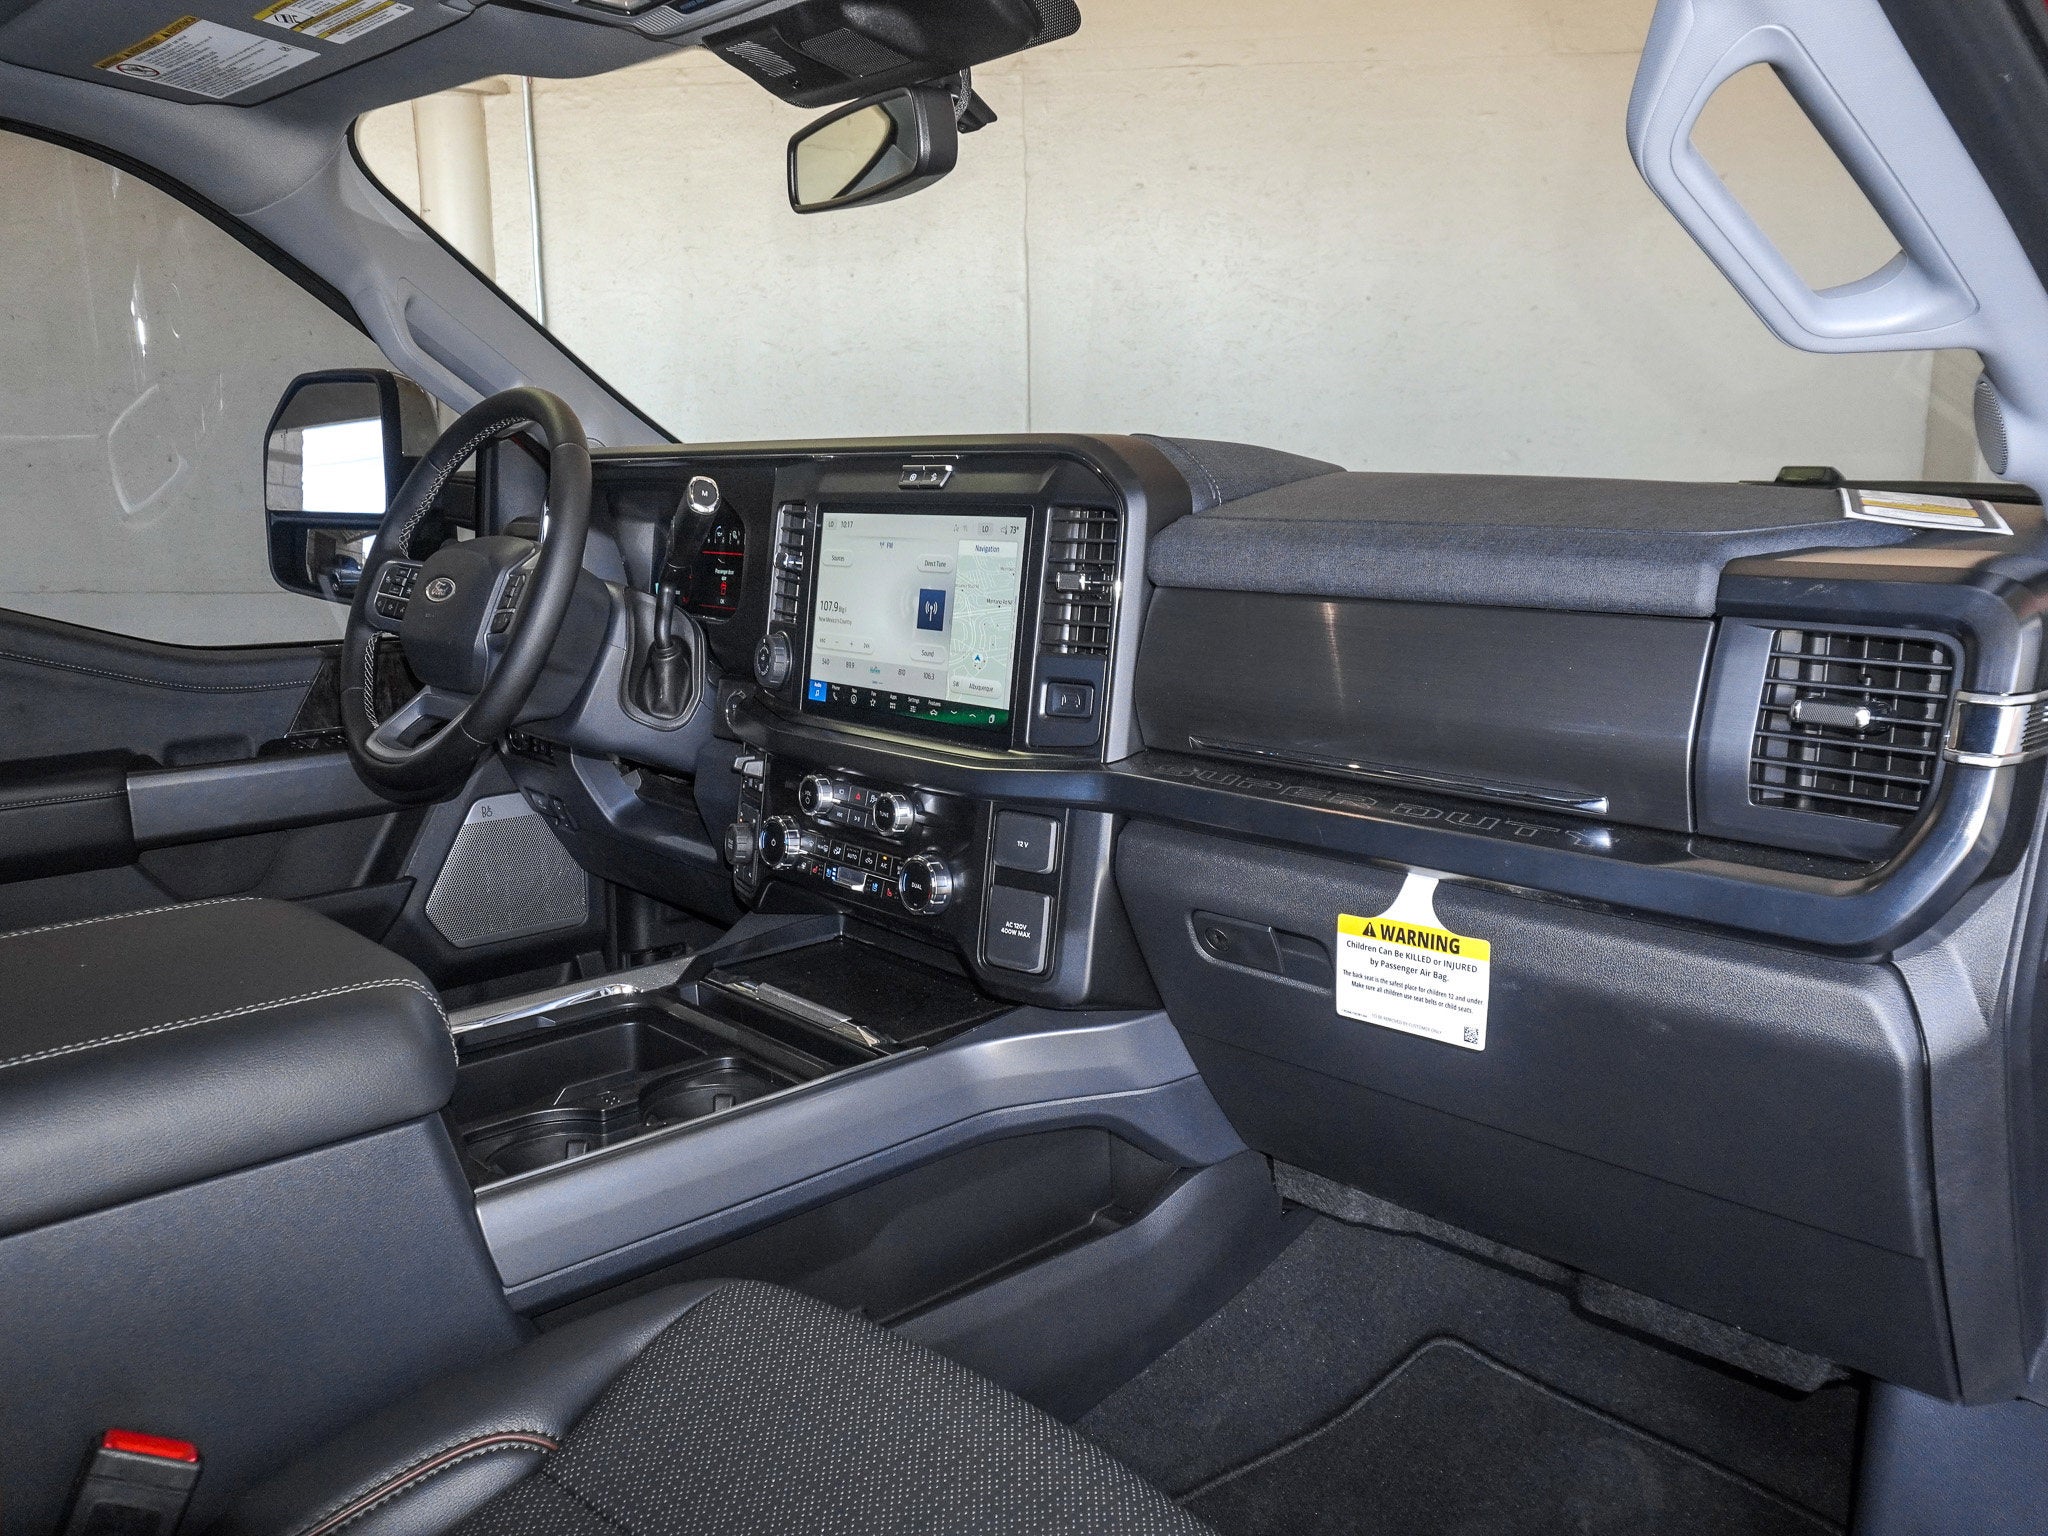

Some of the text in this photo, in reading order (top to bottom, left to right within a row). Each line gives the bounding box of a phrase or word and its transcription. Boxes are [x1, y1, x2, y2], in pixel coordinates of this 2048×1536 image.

[975, 545, 1000, 553] Navigation
[820, 600, 839, 612] 107.9
[921, 650, 934, 658] Sound
[879, 810, 889, 818] TUNE
[1017, 840, 1023, 848] 12
[847, 852, 858, 860] AUTO
[911, 881, 922, 890] DUAL
[1013, 922, 1027, 930] 120V
[1018, 930, 1031, 938] MAX
[1380, 924, 1460, 954] WARNING
[1346, 940, 1377, 953] Children
[1378, 947, 1392, 956] Can
[1394, 950, 1404, 958] Be
[1406, 952, 1431, 964] KILLED
[1443, 961, 1477, 973] INJURED
[1370, 958, 1449, 982] by Passenger Air Bag.
[1343, 969, 1351, 977] The
[1352, 971, 1362, 979] back
[1364, 974, 1374, 982] seat
[1380, 977, 1388, 985] the
[1389, 979, 1403, 988] safest
[1404, 983, 1417, 992] place
[1427, 986, 1447, 998] children
[1455, 993, 1465, 1002] and
[1466, 997, 1483, 1005] under
[1351, 981, 1364, 989] Make
[1384, 987, 1403, 998] children
[1414, 995, 1424, 1003] seat
[1425, 997, 1437, 1006] belts
[1445, 1001, 1457, 1011] child
[1458, 1005, 1473, 1014] seats.
